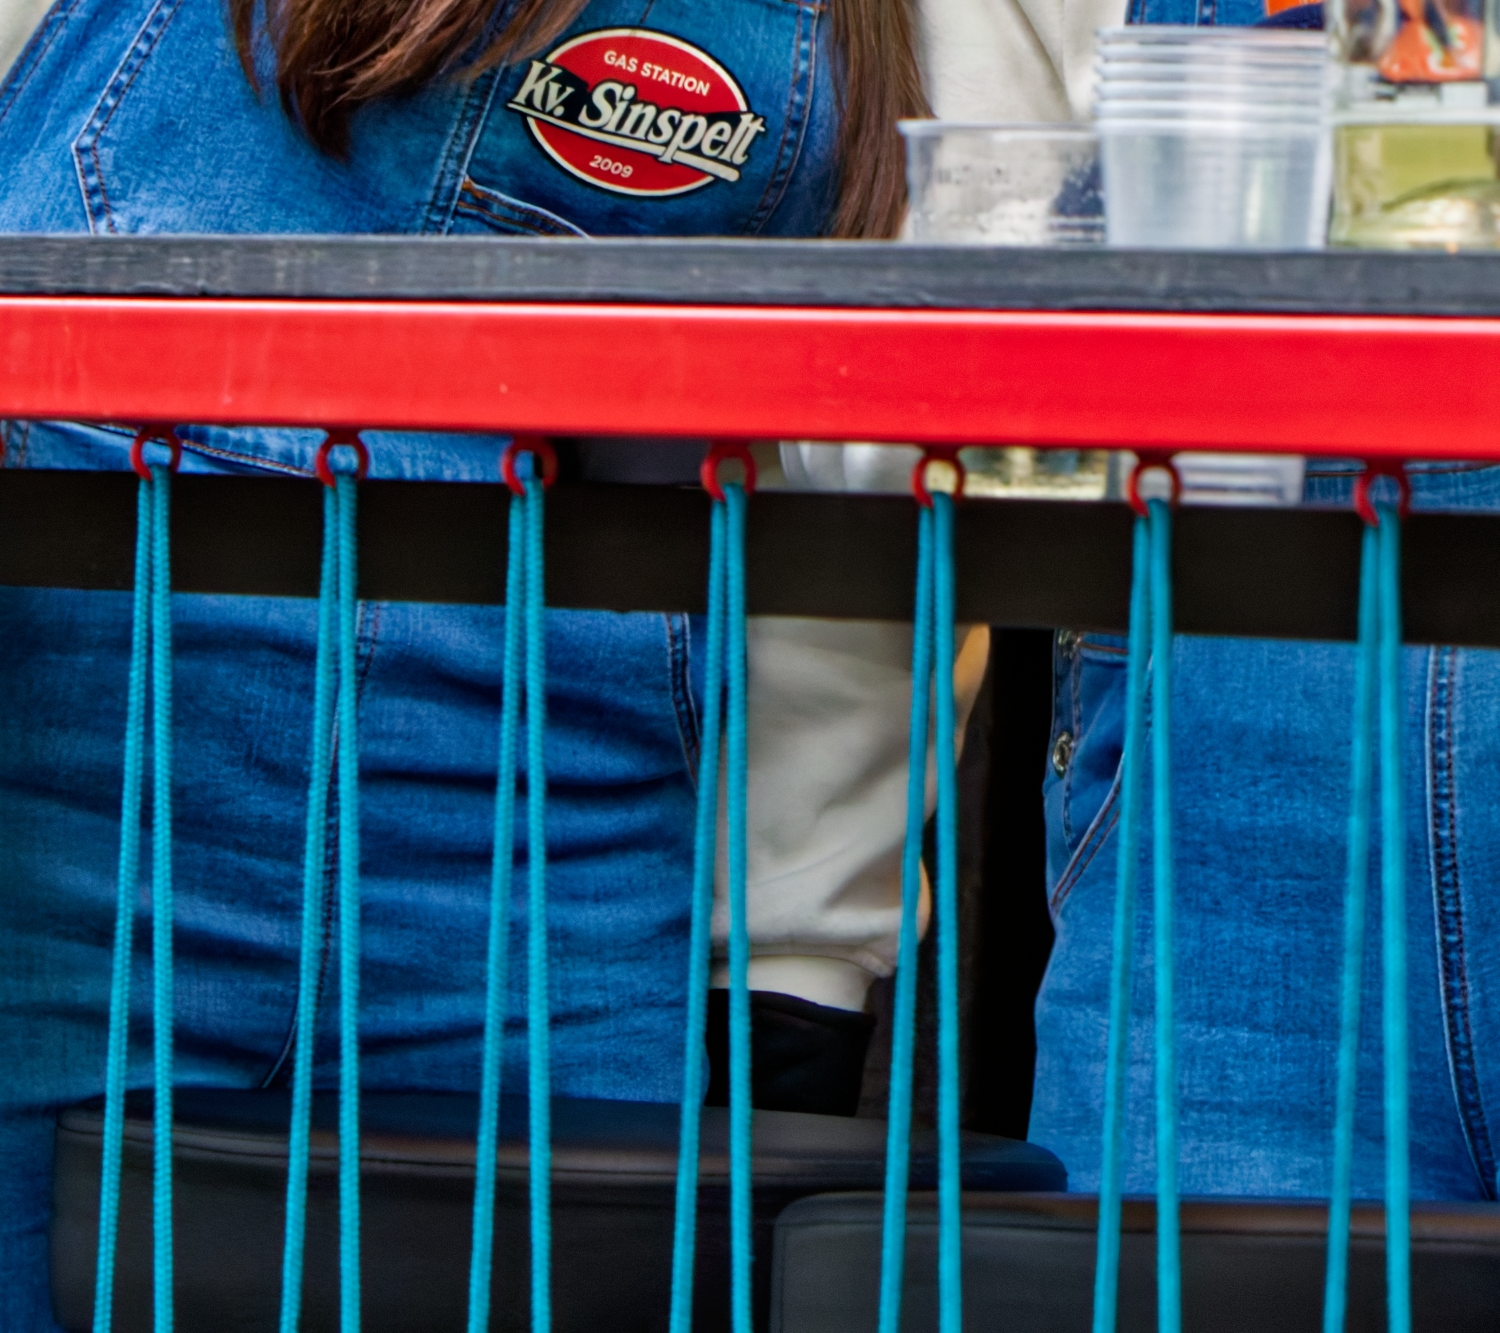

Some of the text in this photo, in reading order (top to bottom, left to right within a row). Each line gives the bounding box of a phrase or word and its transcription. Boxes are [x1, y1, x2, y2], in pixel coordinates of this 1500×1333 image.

[604, 50, 710, 96] GAS STATION
[516, 61, 766, 164] Kv. Sinspelt
[589, 155, 633, 178] 2009
